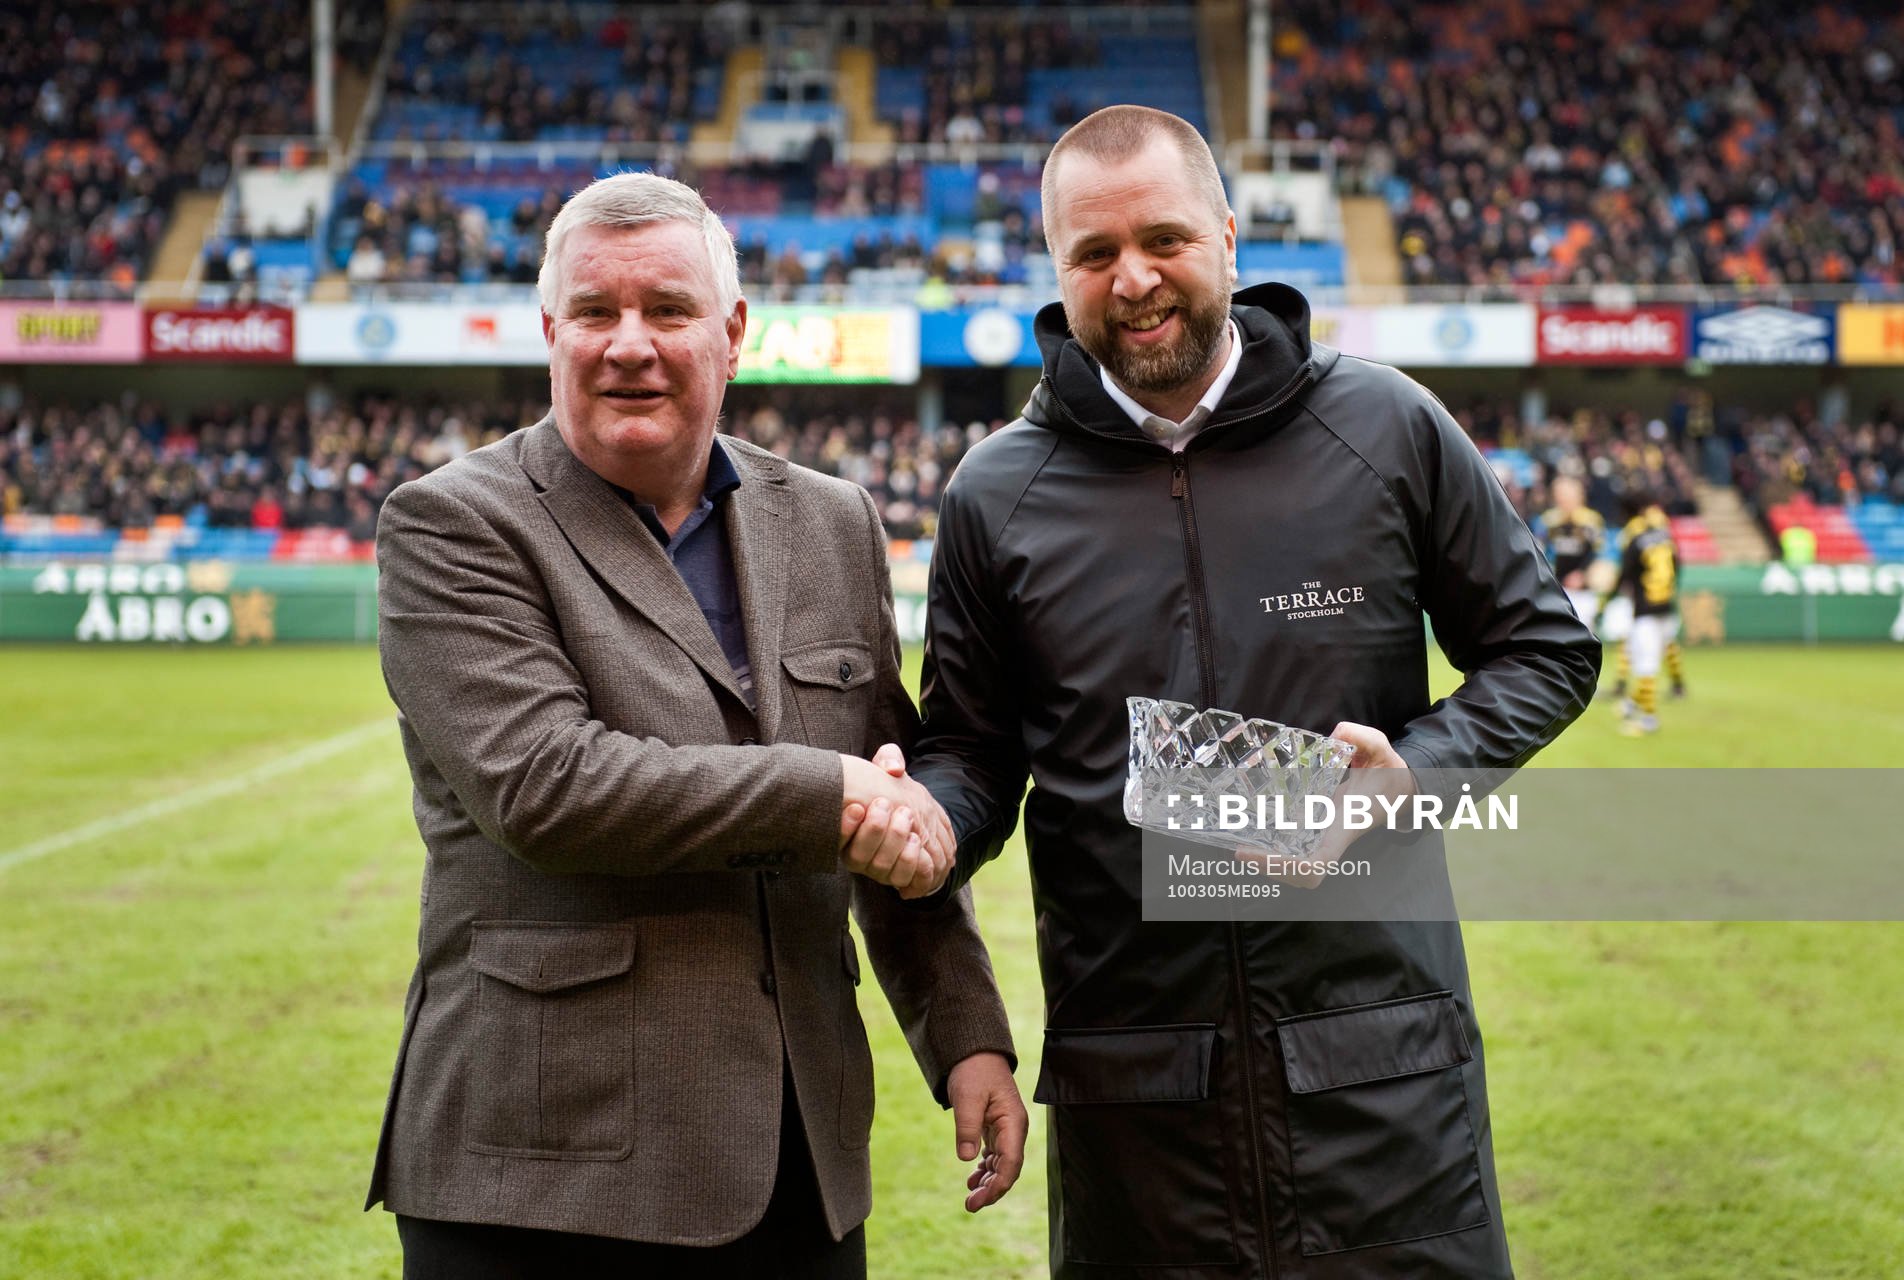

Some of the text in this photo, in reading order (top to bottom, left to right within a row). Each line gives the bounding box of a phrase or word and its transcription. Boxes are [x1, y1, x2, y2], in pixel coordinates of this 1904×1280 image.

[151, 311, 287, 352] Scandic
[1542, 313, 1677, 355] Scandic
[1302, 581, 1322, 590] THE
[1260, 586, 1365, 613] TERRACE
[1287, 607, 1345, 620] STOCKHOLM
